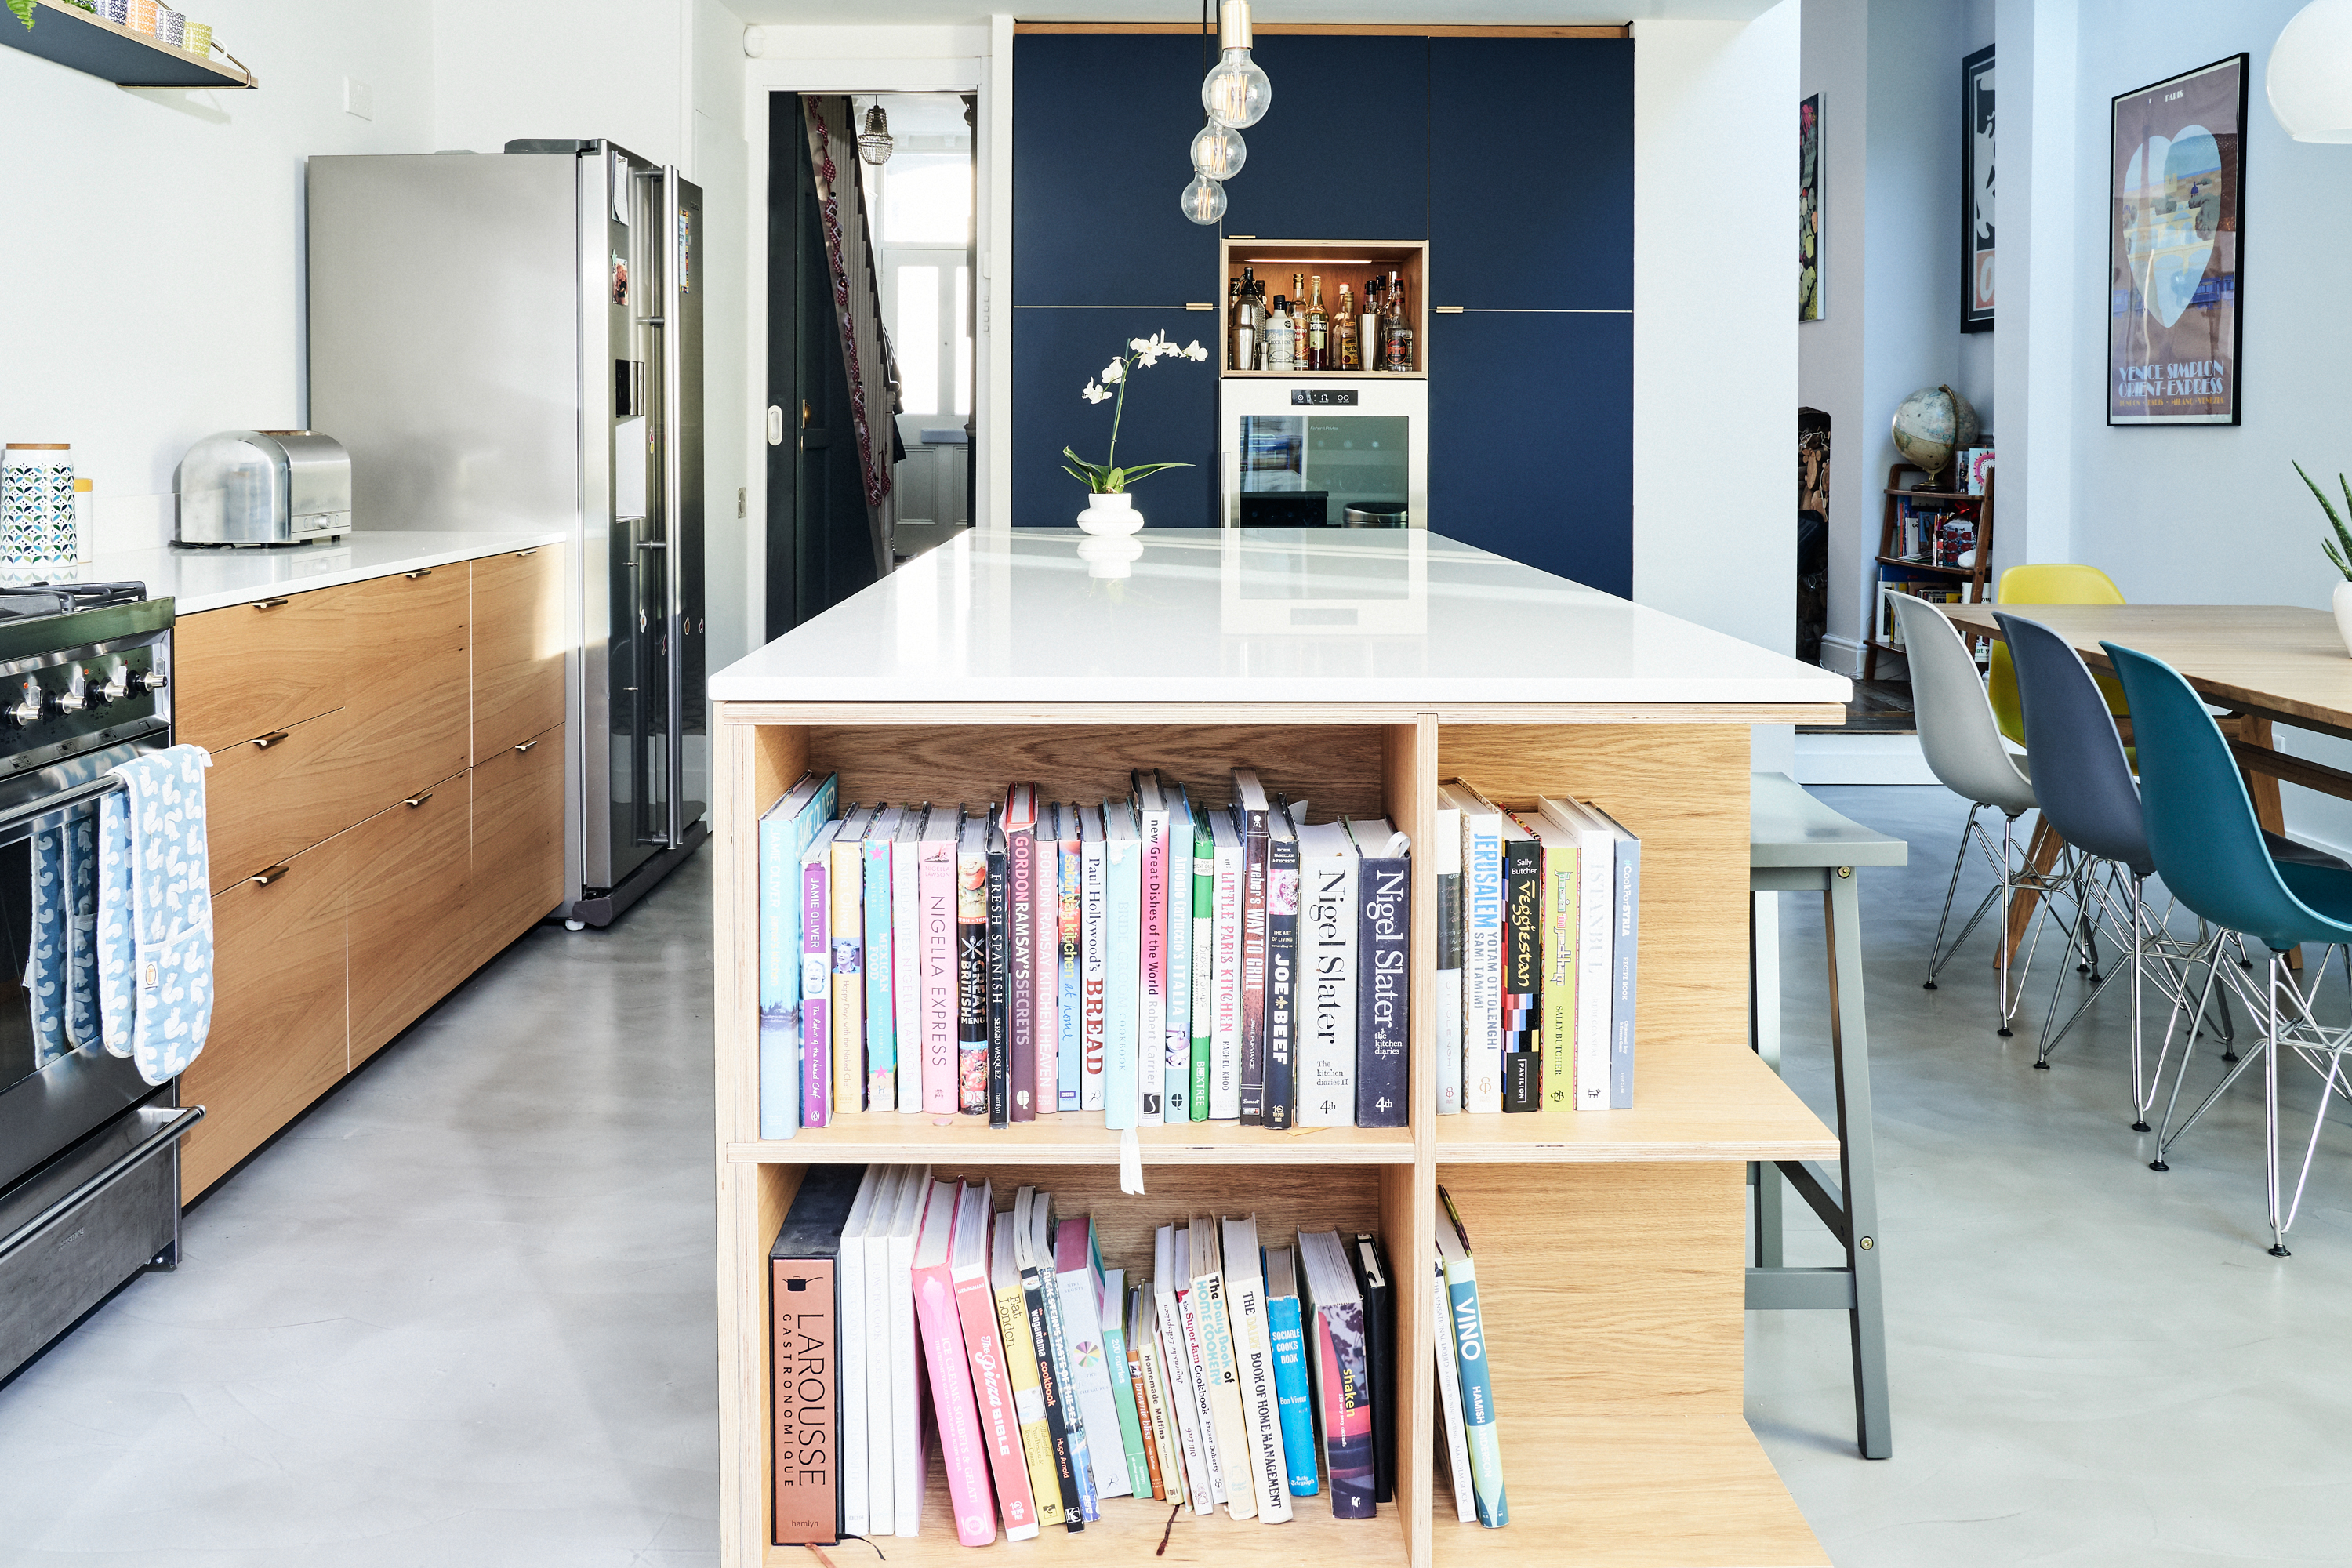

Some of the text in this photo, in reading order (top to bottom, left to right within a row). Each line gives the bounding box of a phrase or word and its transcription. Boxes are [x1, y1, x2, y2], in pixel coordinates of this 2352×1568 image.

[2165, 89, 2183, 102] PARIS
[2118, 377, 2223, 398] ORIENT-EXPRESS
[2119, 359, 2224, 381] VENICE SIMPLON
[2198, 397, 2224, 405] VENEZIA
[770, 828, 781, 907] JAMIE OLIVER
[1040, 851, 1051, 908] GORDON
[1517, 858, 1533, 867] Sally
[810, 877, 820, 948] JAMIE OLIVER
[991, 873, 1003, 926] FRESH
[1060, 854, 1078, 978] saturday kitchen
[1221, 872, 1235, 920] LITTLE
[1588, 864, 1605, 974] ISTANBUL
[1040, 912, 1051, 966] RAMSAY
[1147, 819, 1160, 1078] new Great Dishes of the World Robert Carrier
[1172, 855, 1188, 1016] Antonio Carluccio's ITALIA
[1220, 925, 1235, 964] PARIS
[1245, 862, 1265, 992] weber's WAY TO GRILL
[1366, 869, 1404, 1028] Nigel Slater
[1474, 834, 1498, 1050] JERUSALEM YOTAM OTTOLENGHI
[869, 946, 879, 981] FOOD
[879, 932, 889, 993] MEXICAN
[900, 863, 915, 1082] NIGELLA BITES NIGELLA LAWSON
[931, 896, 947, 1066] NIGELLA EXPRESS
[991, 934, 1003, 1004] SPANISH
[1086, 858, 1104, 1076] Paul Hollywood's BREAD
[1309, 869, 1347, 1044] Nigel Slater
[1474, 931, 1485, 1009] SAMI TAMIMI
[840, 980, 850, 1001] Happy
[840, 1004, 850, 1021] Days
[960, 960, 971, 1018] BRITISH
[972, 960, 985, 1016] GREAT
[1040, 972, 1052, 1029] KITCHEN
[1117, 902, 1129, 1072] BRIDE GROOM COOKBOOK
[1219, 968, 1234, 1033] KITCHEN
[1272, 953, 1290, 1065] JOE BEEF
[993, 1045, 1002, 1080] VASQUEZ
[1040, 1033, 1052, 1087] HEAVEN
[1374, 1047, 1400, 1055] diaries
[1555, 1033, 1563, 1076] BUTCHER
[993, 1092, 1002, 1114] hamlyn
[1320, 1100, 1336, 1114] 4th
[1375, 1097, 1393, 1112] 4th
[957, 1283, 985, 1294] GEMIGNANI
[1009, 1294, 1023, 1319] Eat
[998, 1297, 1015, 1348] London
[1185, 1312, 1200, 1364] SuperJam
[1196, 1279, 1223, 1386] HOME COOKERY
[1208, 1275, 1235, 1384] The Dairy Book of
[1272, 1328, 1300, 1341] SOCIABLE
[1276, 1341, 1298, 1352] COOK'S
[1055, 1336, 1066, 1370] TASTE
[1112, 1338, 1126, 1385] 200 curries
[1280, 1352, 1298, 1365] BOOK
[782, 1313, 793, 1486] GASTRONOMIQUE
[797, 1313, 826, 1486] LAROUSSE
[937, 1349, 956, 1432] DEFINITIVE CAROLINE
[975, 1352, 1011, 1456] Pizza BIBLE
[1031, 1308, 1046, 1357] wagamama
[1040, 1360, 1057, 1407] cookbook
[1060, 1456, 1070, 1479] Arnold
[1080, 1385, 1109, 1395] THESAURUS
[1134, 1382, 1152, 1440] brownie bliss
[1145, 1354, 1166, 1440] Homemade Muffins
[1194, 1363, 1210, 1416] Cookbook
[1242, 1290, 1283, 1510] THE DAIRY BOOK OF HOME MANAGEMENT
[1279, 1396, 1307, 1405] Bon Viveur
[1343, 1367, 1357, 1417] shaken
[1435, 1296, 1447, 1340] SENSATIONAL
[1454, 1445, 1465, 1481] MALCOLM
[1460, 1481, 1468, 1504] GLUCK
[1456, 1296, 1493, 1479] VINO HAMISH ANDERSON
[942, 1336, 978, 1504] ICE CREAMS, SORBETS GELATI
[1205, 1420, 1214, 1443] Fraser
[1207, 1444, 1219, 1473] Doherty
[1290, 1479, 1316, 1487] Telegraph
[791, 1519, 818, 1529] hamlyn
